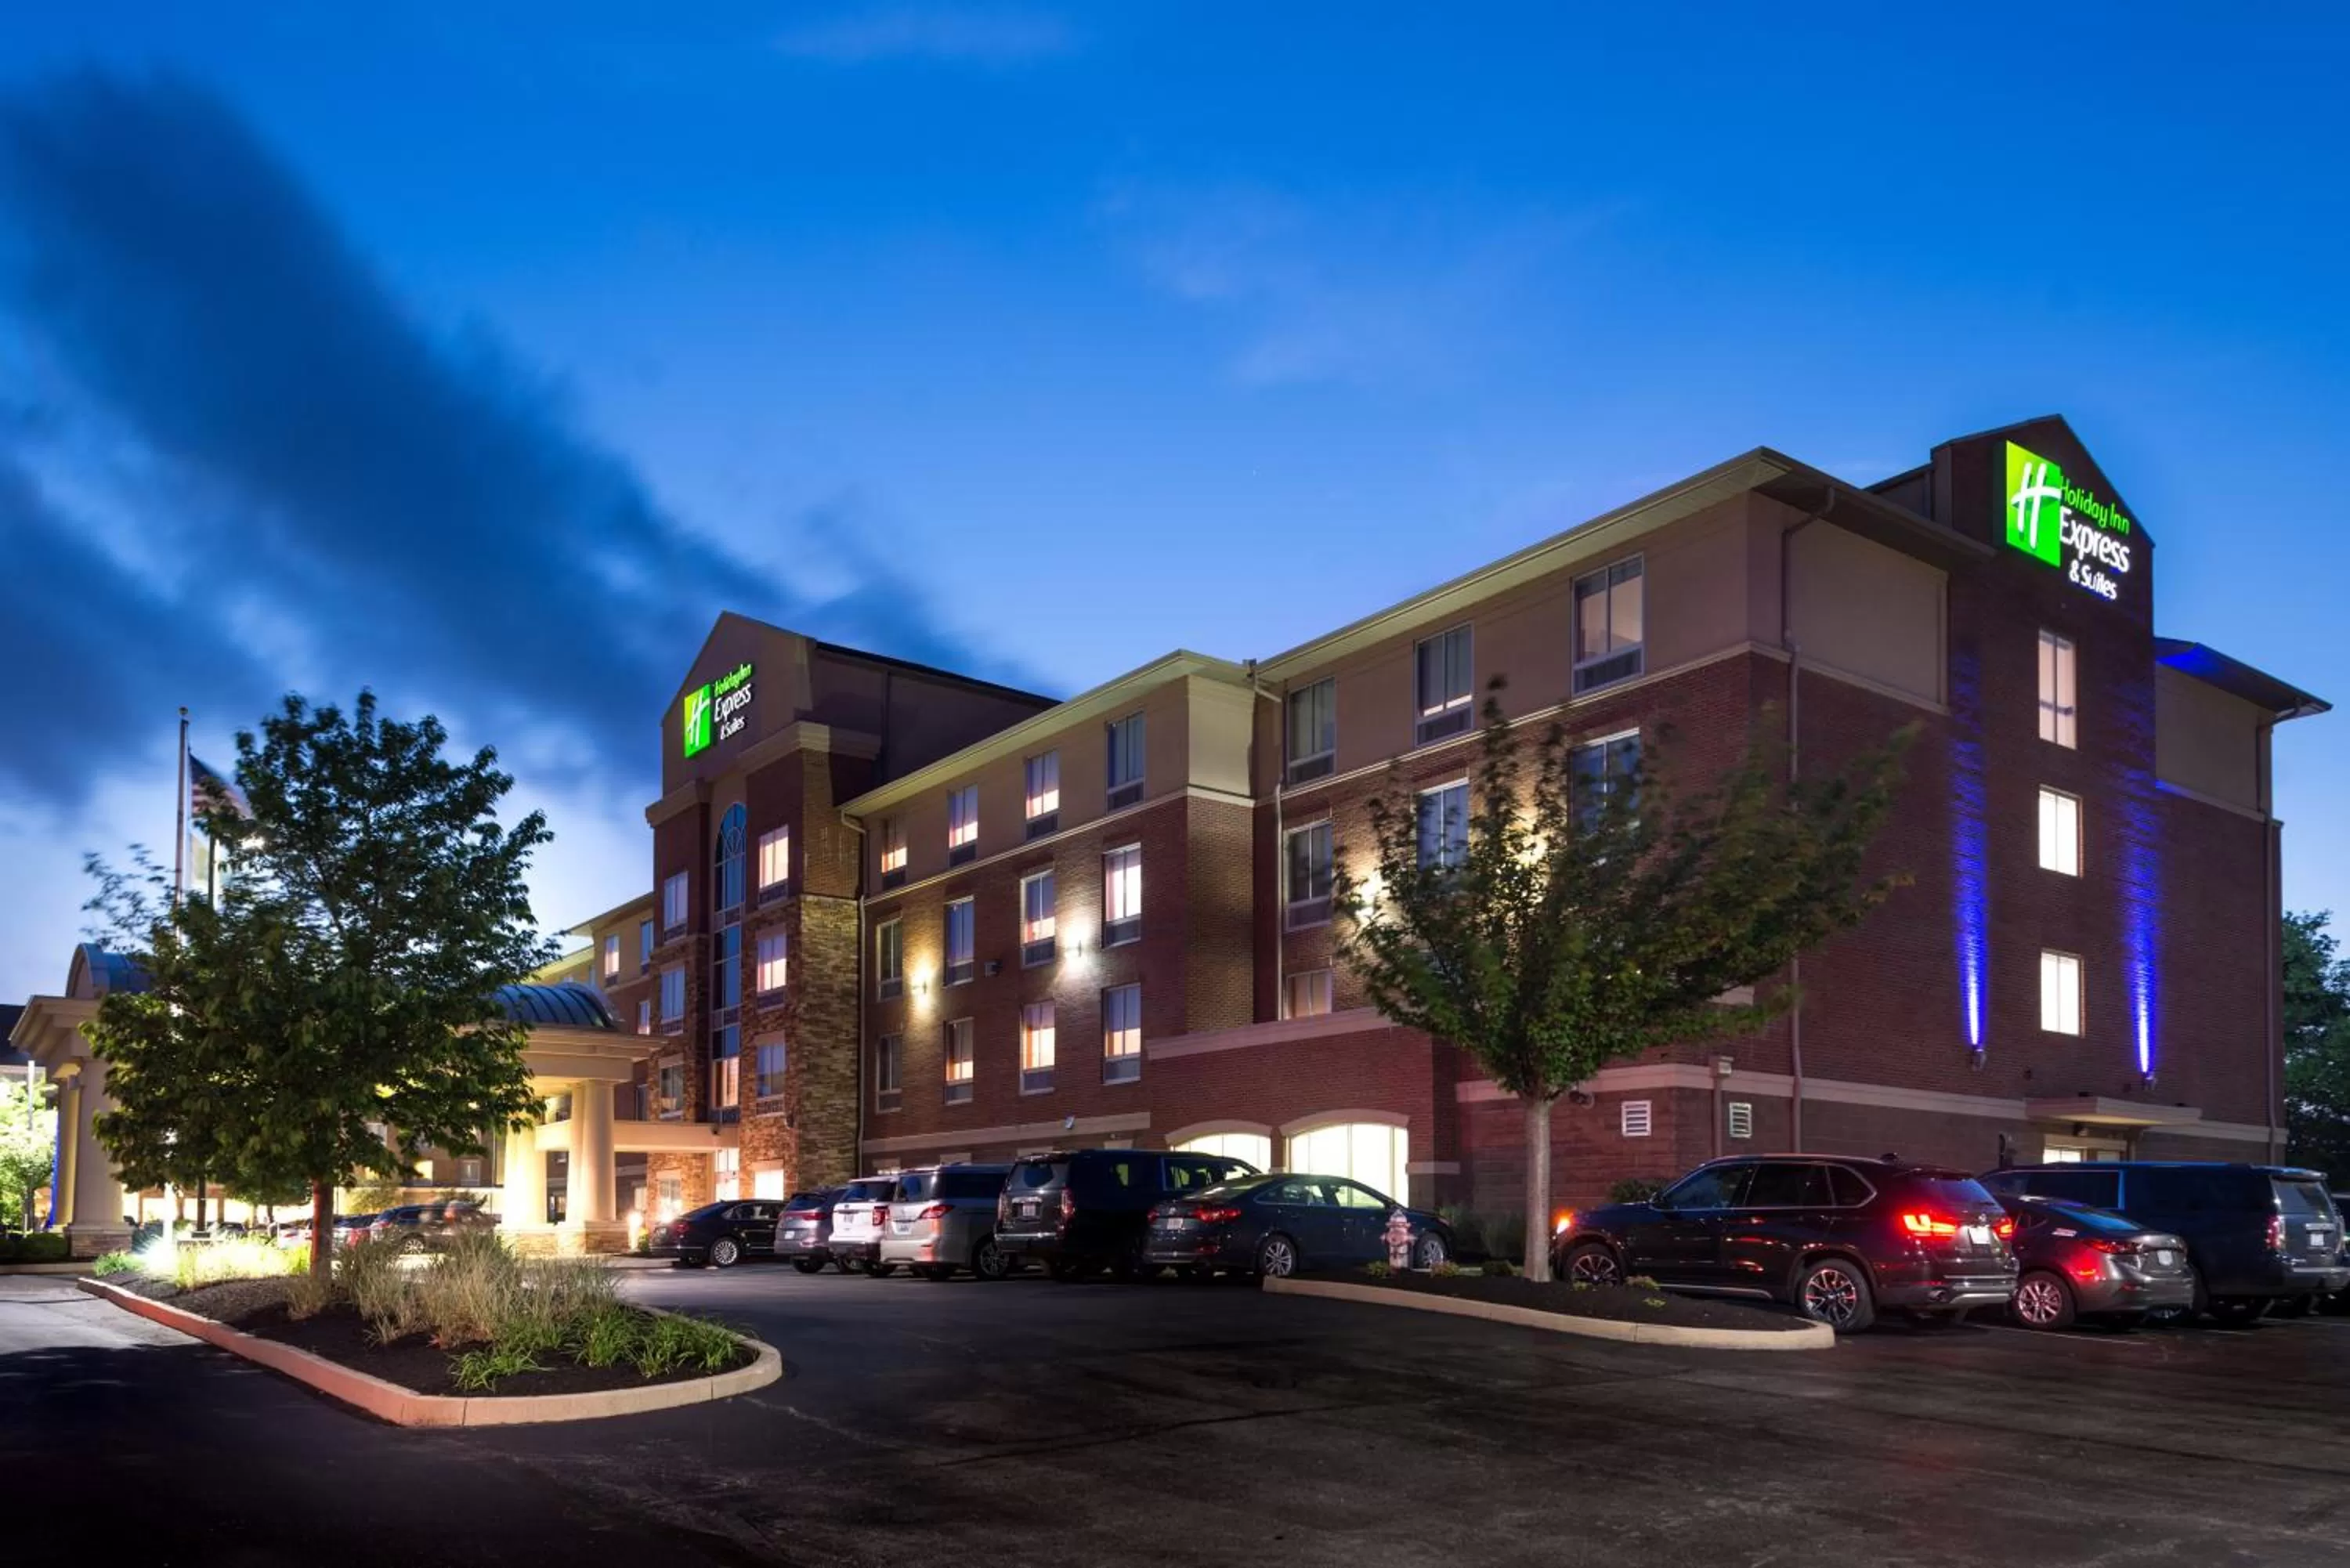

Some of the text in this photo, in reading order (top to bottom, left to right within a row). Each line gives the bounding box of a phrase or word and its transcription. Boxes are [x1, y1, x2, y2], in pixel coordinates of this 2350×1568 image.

[2059, 476, 2130, 534] Holiday Inn
[2059, 506, 2130, 573] Express
[2069, 559, 2117, 600] & Suites
[714, 683, 751, 722] Express
